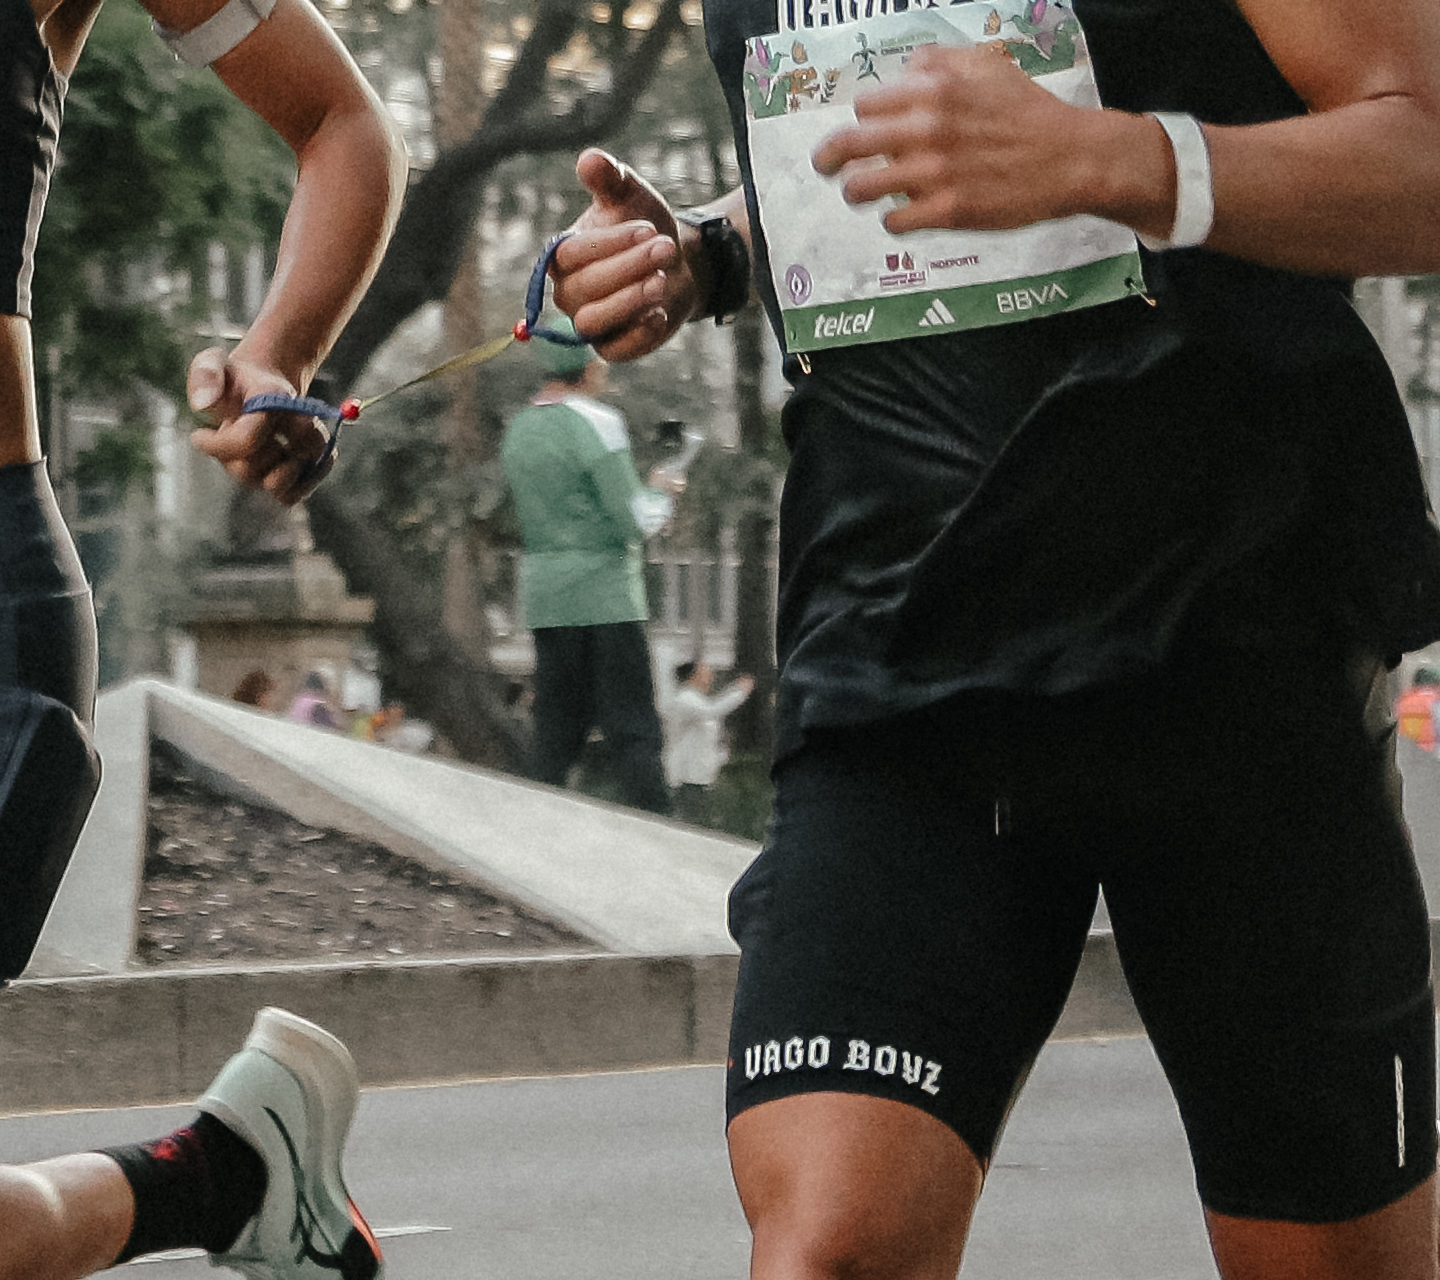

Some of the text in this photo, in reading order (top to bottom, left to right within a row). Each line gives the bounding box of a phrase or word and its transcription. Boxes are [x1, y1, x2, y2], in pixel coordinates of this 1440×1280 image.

[814, 282, 1069, 339] telcel BBVA
[842, 1038, 943, 1096] BOYZ
